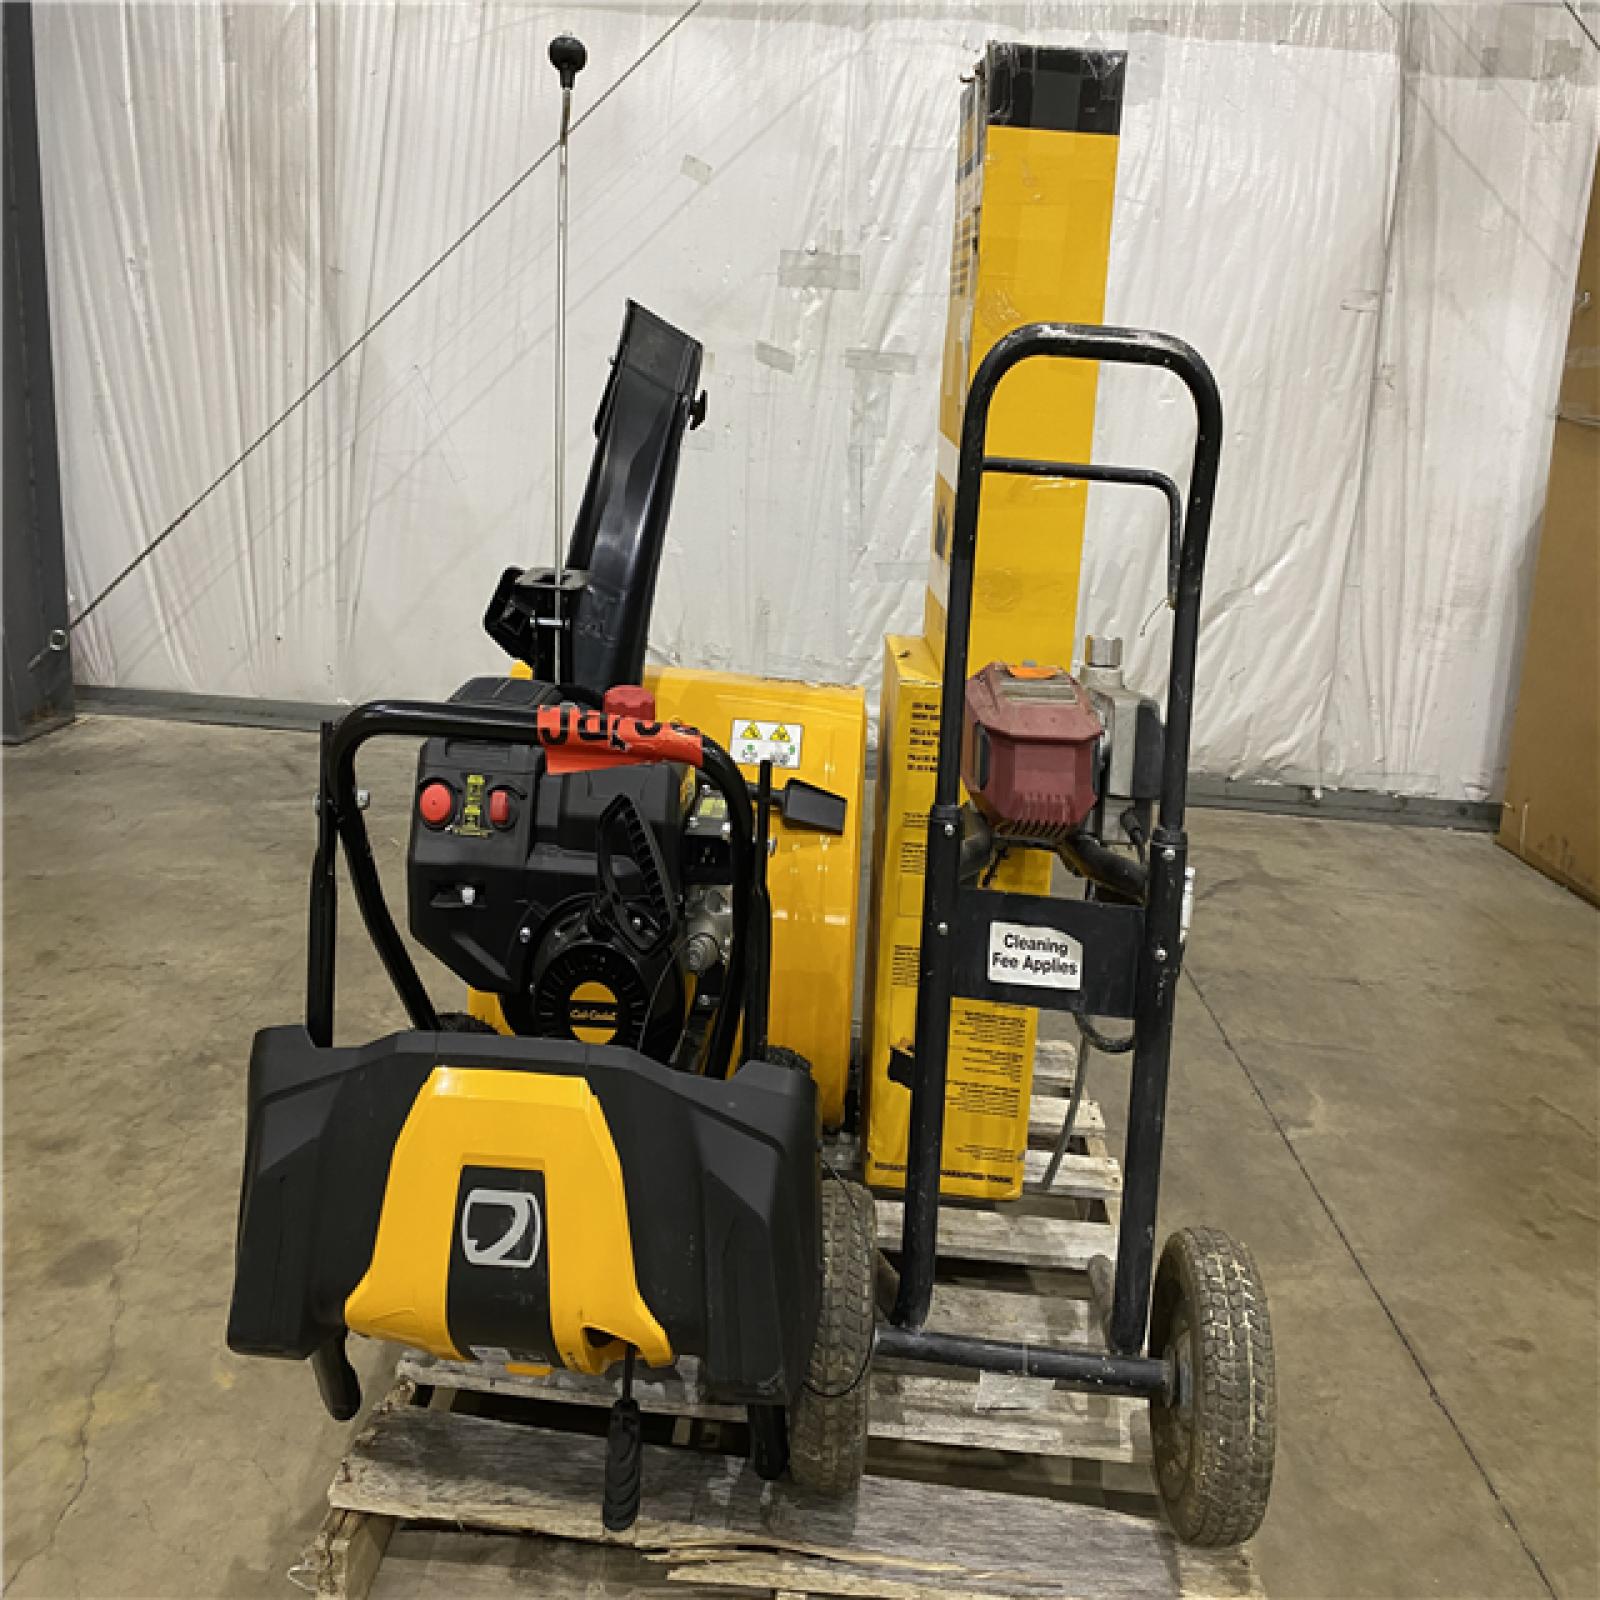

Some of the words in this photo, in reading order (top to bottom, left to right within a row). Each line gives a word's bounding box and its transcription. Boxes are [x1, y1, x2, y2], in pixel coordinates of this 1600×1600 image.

[1004, 933, 1068, 957] Cleaning
[992, 952, 1018, 967] Fee
[1022, 955, 1078, 975] Applies
